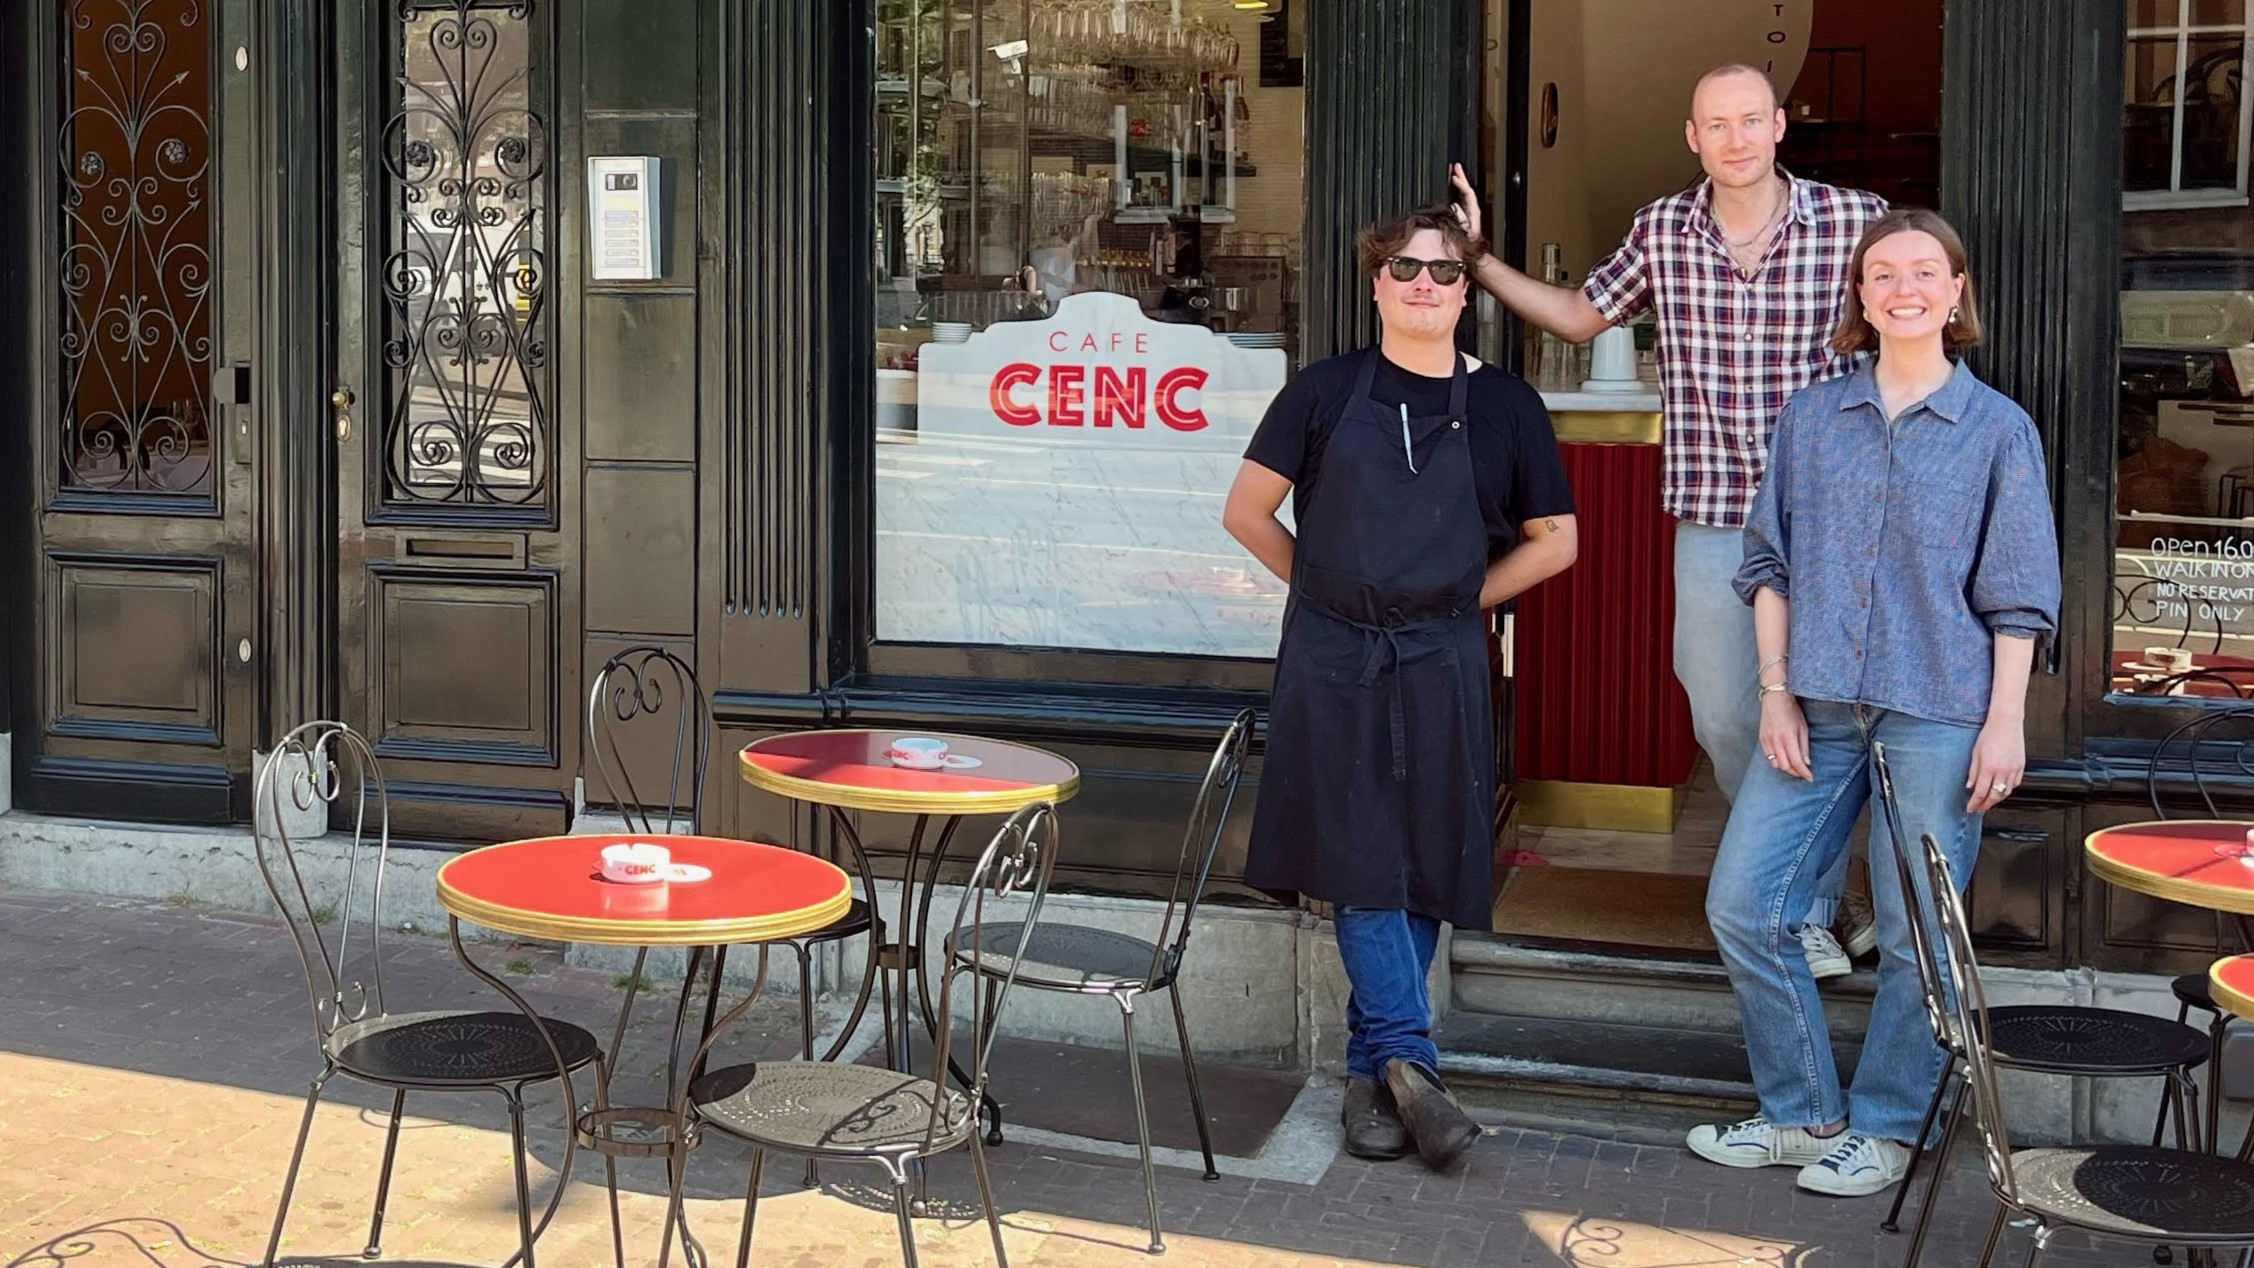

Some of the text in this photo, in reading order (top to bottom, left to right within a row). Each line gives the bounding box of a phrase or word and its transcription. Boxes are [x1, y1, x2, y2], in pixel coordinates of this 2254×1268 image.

[1049, 330, 1149, 353] CAFE
[988, 361, 1210, 432] CENC
[2214, 535, 2254, 560] 16.0
[2157, 582, 2175, 598] NO
[2156, 600, 2246, 622] PIN ONLY
